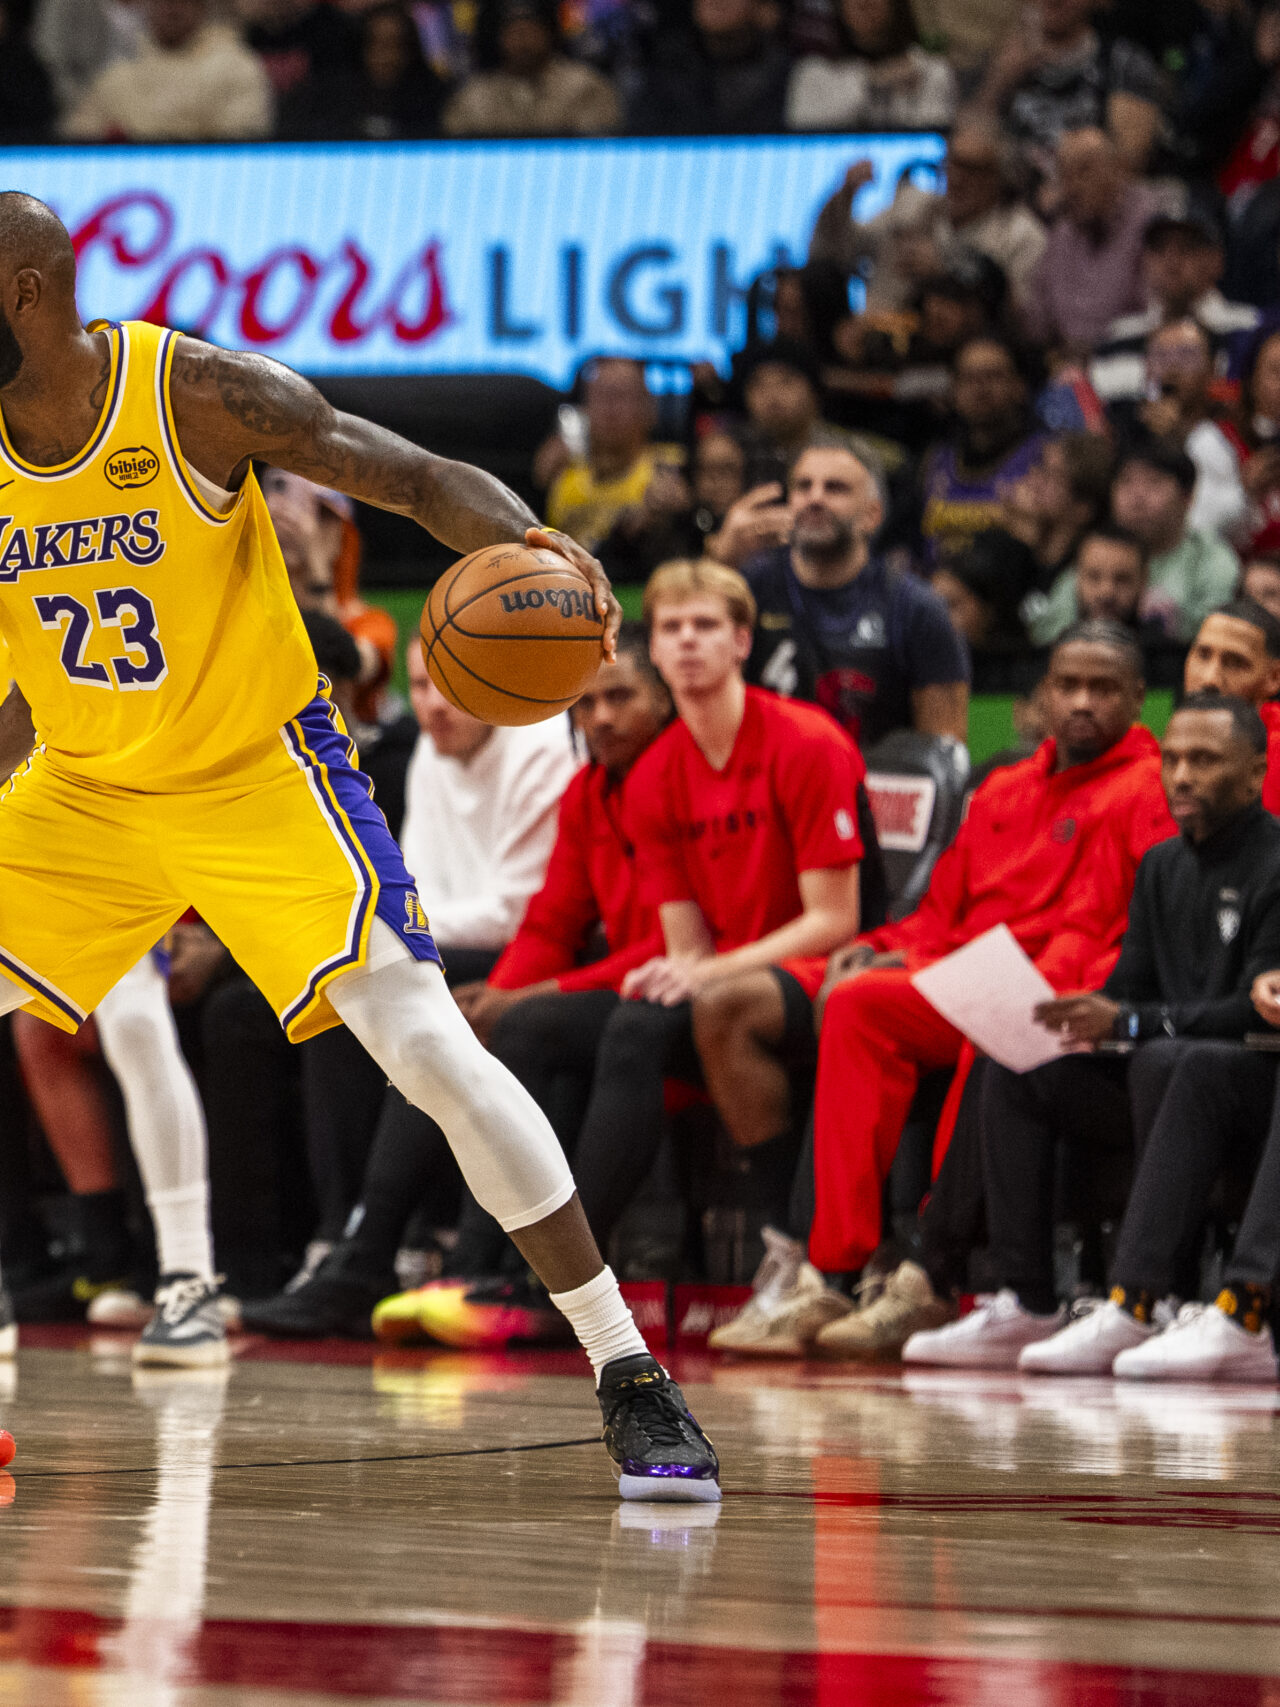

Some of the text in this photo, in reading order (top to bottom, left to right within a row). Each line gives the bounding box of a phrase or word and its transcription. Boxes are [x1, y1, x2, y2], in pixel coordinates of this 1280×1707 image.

[485, 240, 795, 344] LIGH
[108, 457, 157, 476] bibigo
[31, 586, 169, 692] 23
